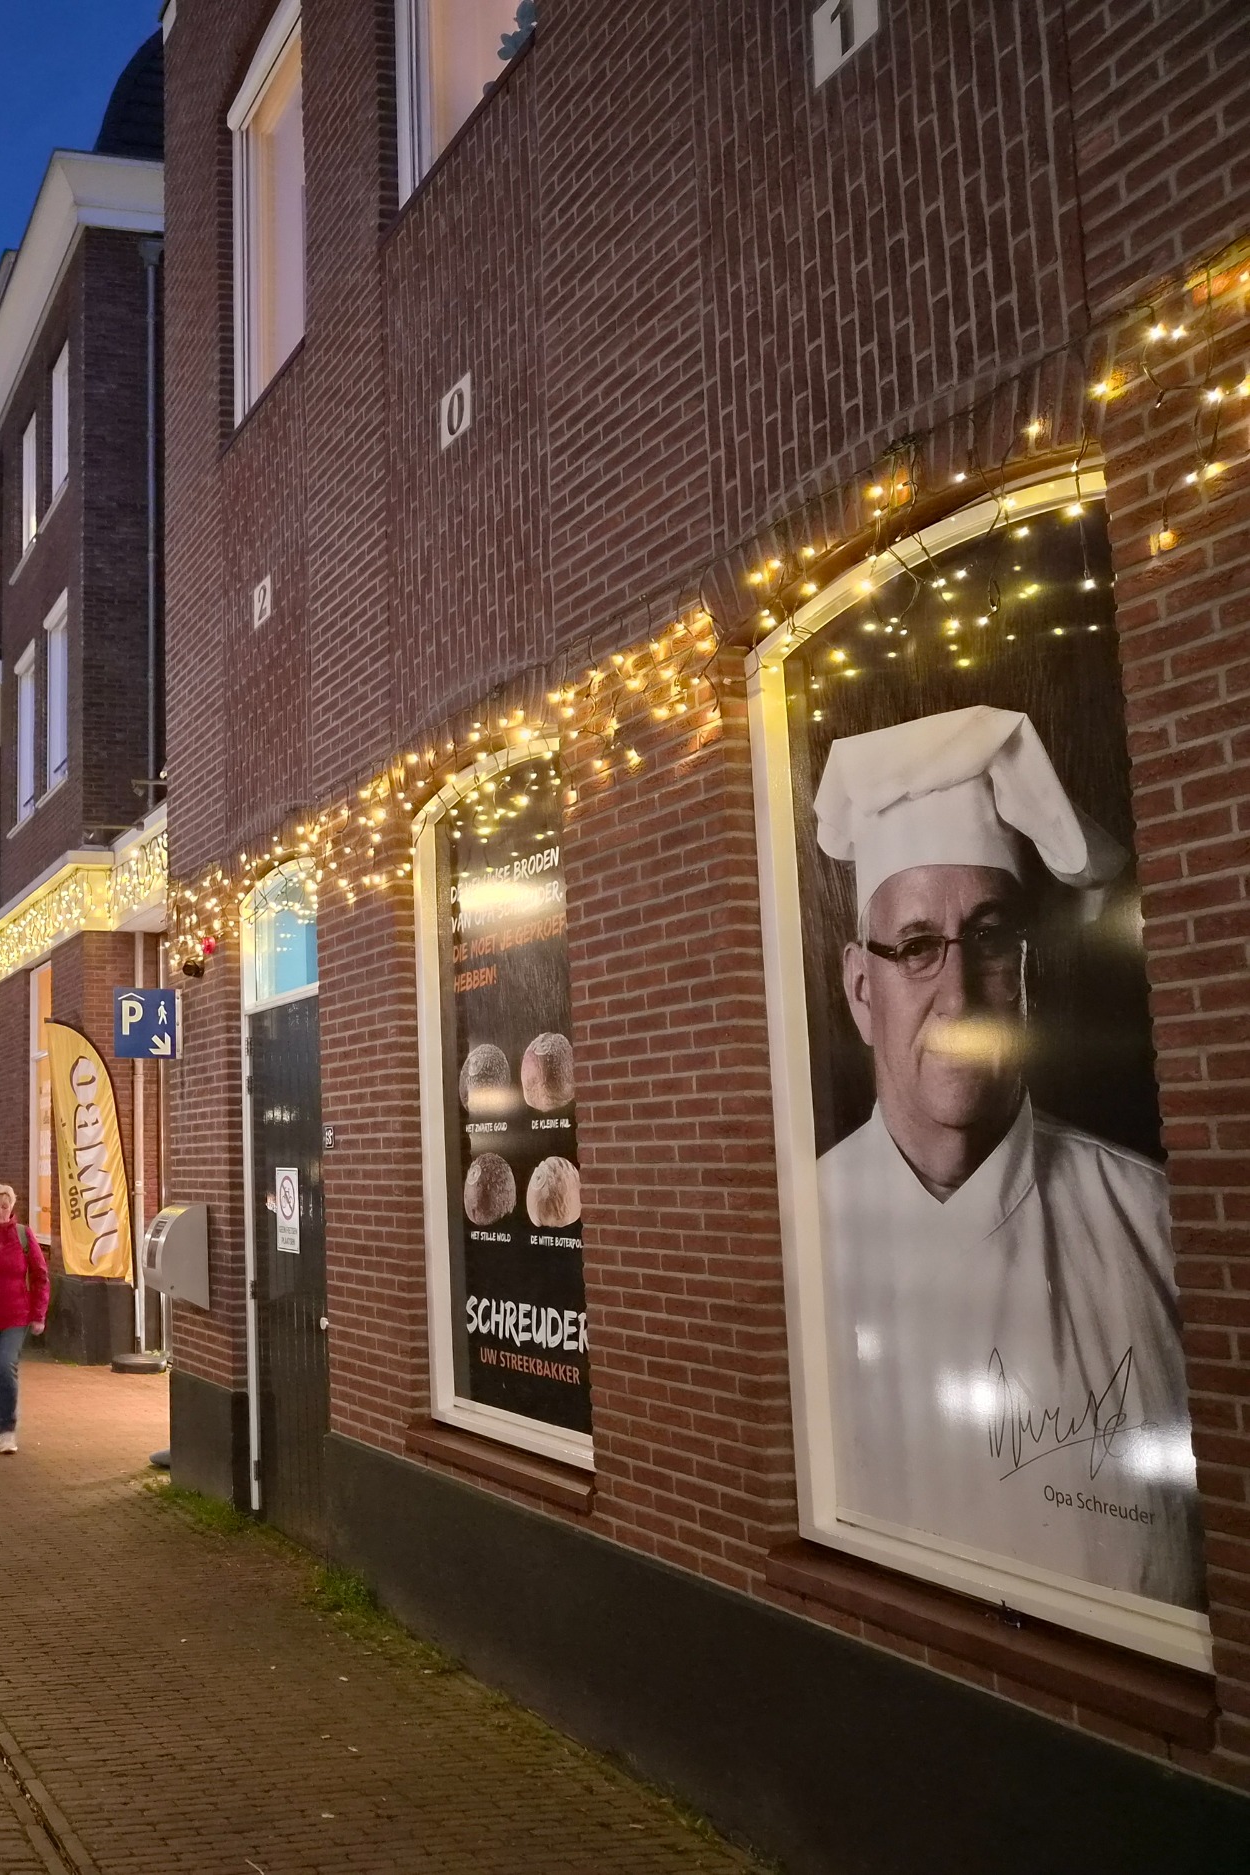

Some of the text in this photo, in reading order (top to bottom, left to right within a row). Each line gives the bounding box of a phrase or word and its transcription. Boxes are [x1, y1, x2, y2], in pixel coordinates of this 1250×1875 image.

[257, 583, 268, 622] 2
[513, 845, 560, 883] BRODEN
[451, 910, 471, 934] VAN
[452, 912, 567, 964] DIE MOET JE GEPROEF
[453, 963, 498, 993] HEBBEN!
[121, 999, 144, 1036] P
[465, 1123, 475, 1133] HET
[493, 1121, 508, 1132] GOUD
[531, 1119, 539, 1130] DE
[540, 1118, 559, 1130] KLEINE
[470, 1230, 512, 1243] HET STILLE WOLD
[530, 1234, 538, 1245] DE
[538, 1235, 554, 1247] WITTE
[466, 1295, 590, 1354] SCHREUDER
[479, 1346, 581, 1385] UW STREEKBAKKER
[1043, 1485, 1156, 1526] Opa Schreuder
